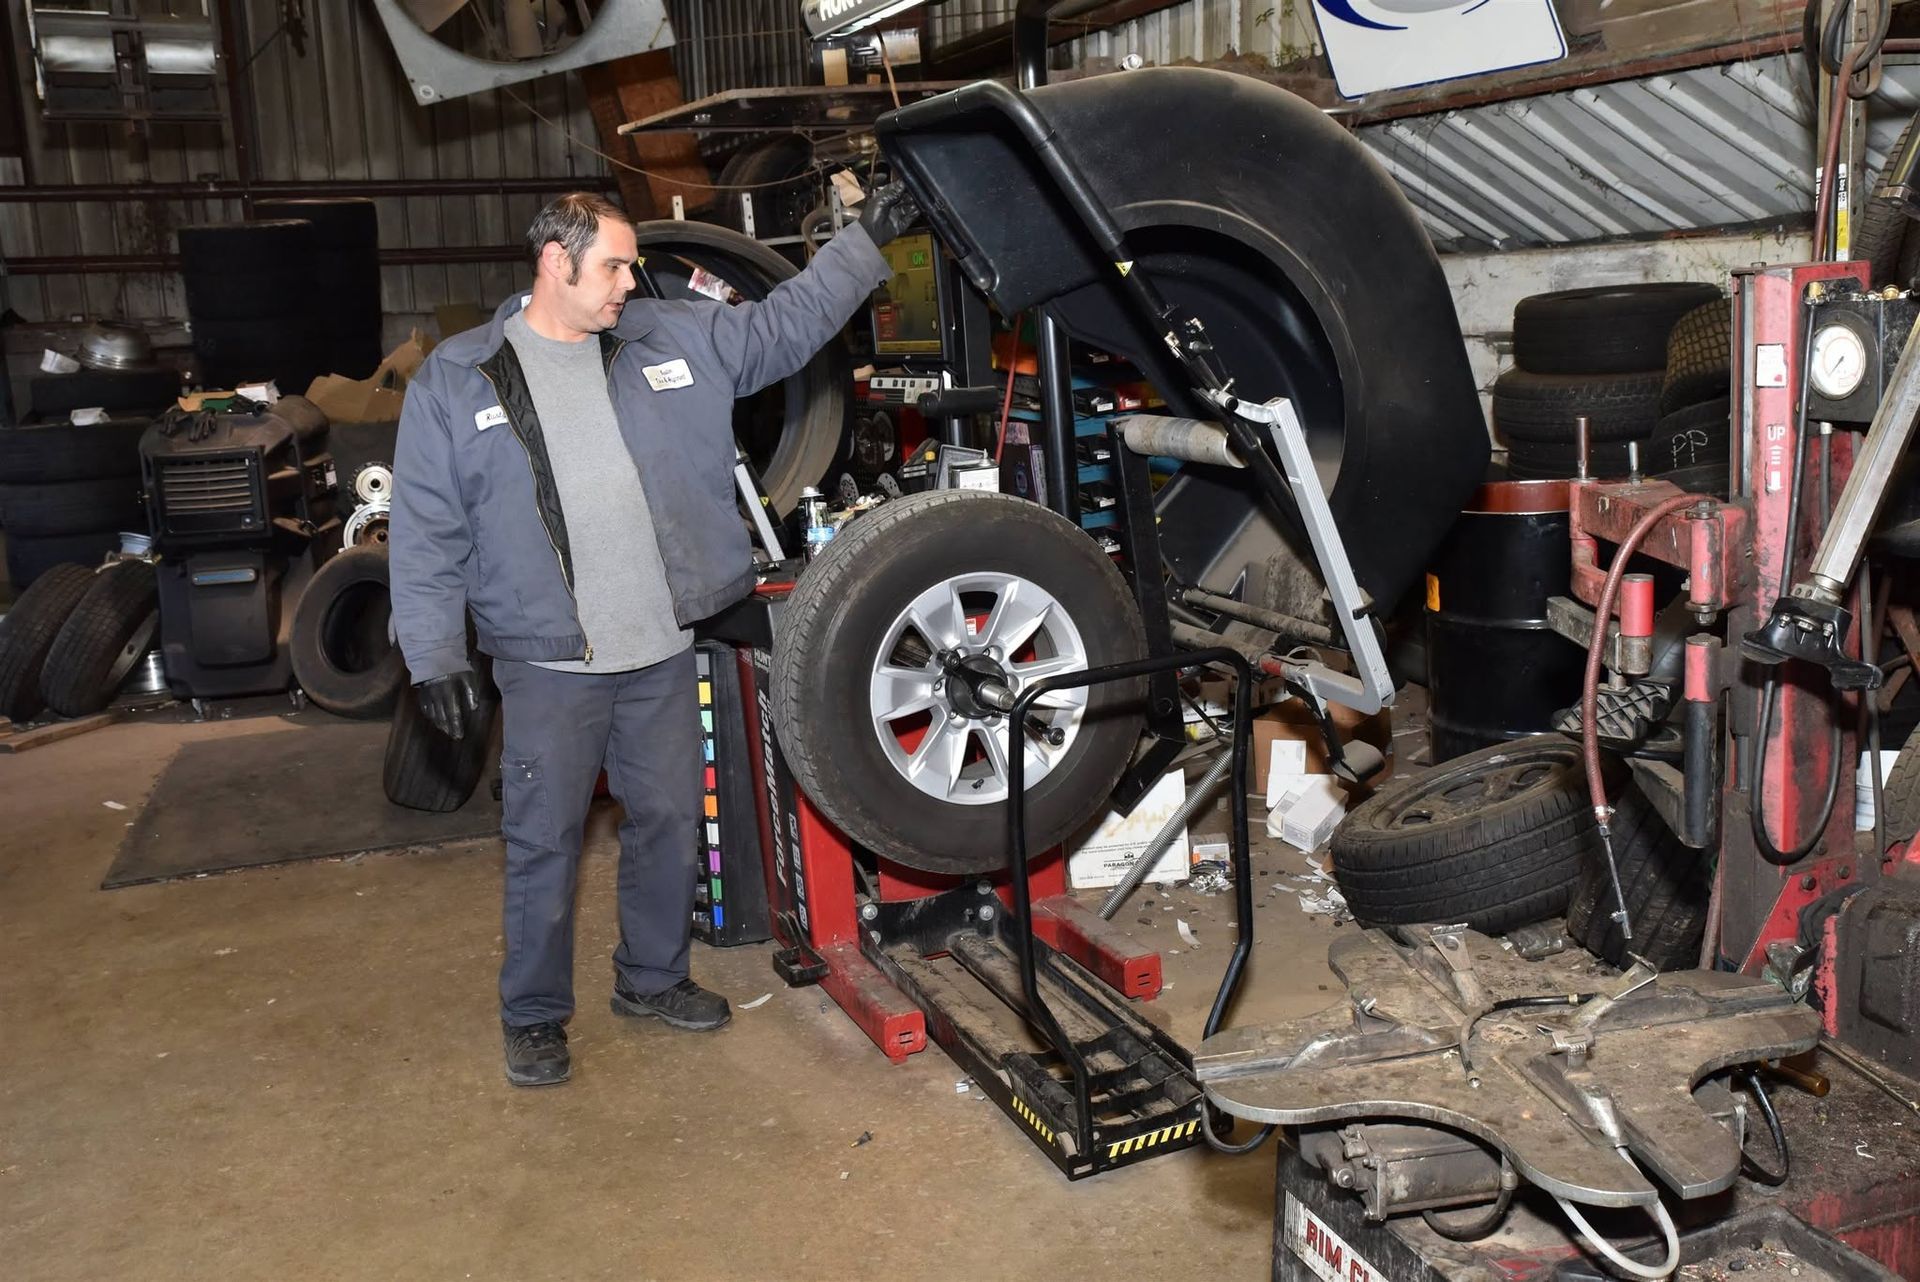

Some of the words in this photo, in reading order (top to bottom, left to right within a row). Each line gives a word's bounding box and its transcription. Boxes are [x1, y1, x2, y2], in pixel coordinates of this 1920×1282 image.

[912, 251, 925, 266] OK
[1767, 426, 1786, 441] UP
[1306, 1218, 1343, 1275] RIM
